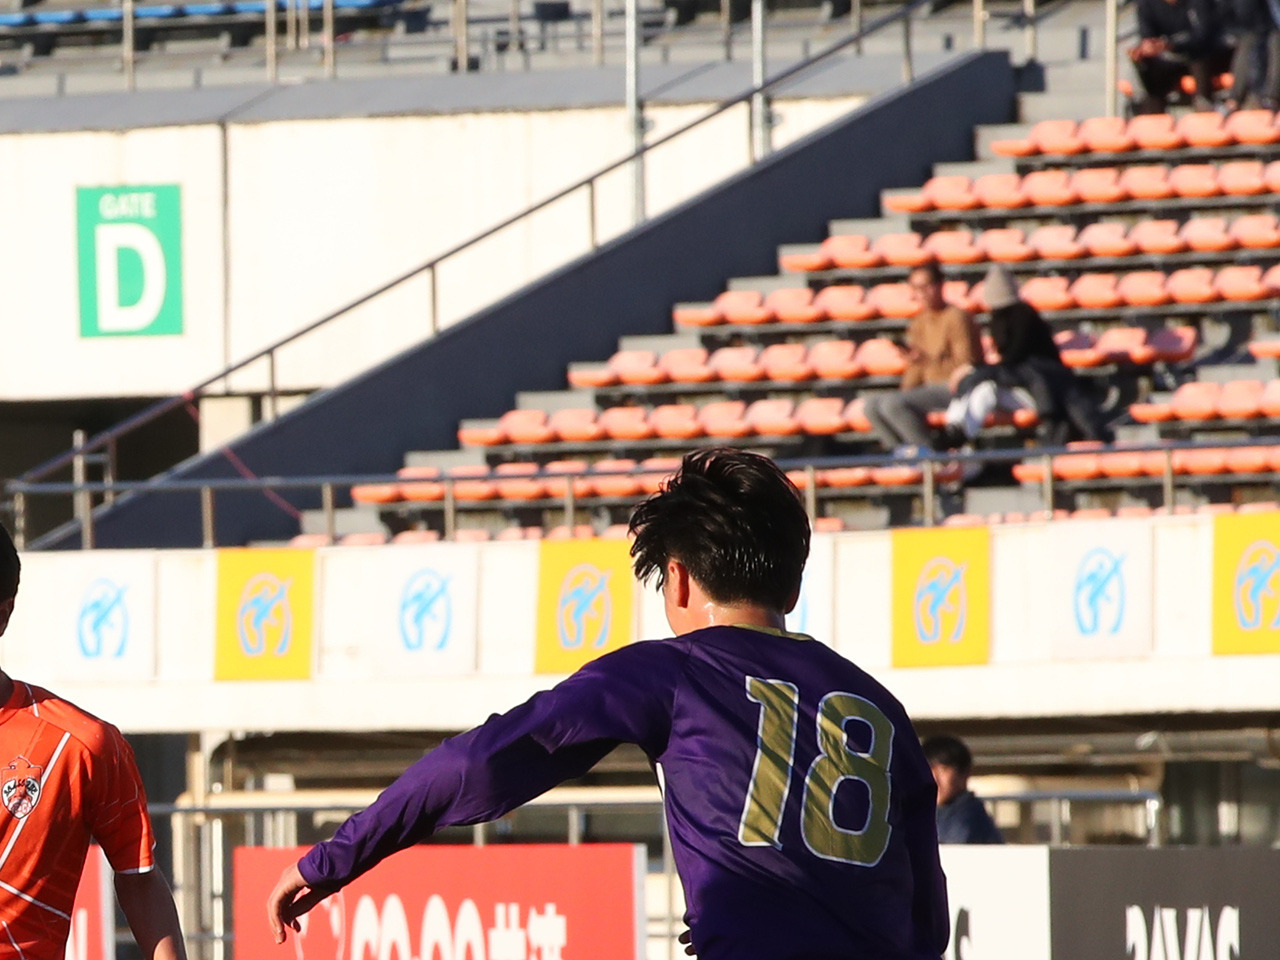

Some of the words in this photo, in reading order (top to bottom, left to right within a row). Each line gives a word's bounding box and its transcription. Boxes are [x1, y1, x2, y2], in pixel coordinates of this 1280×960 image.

[98, 192, 157, 219] GATE
[95, 222, 167, 333] D
[738, 676, 894, 867] 18
